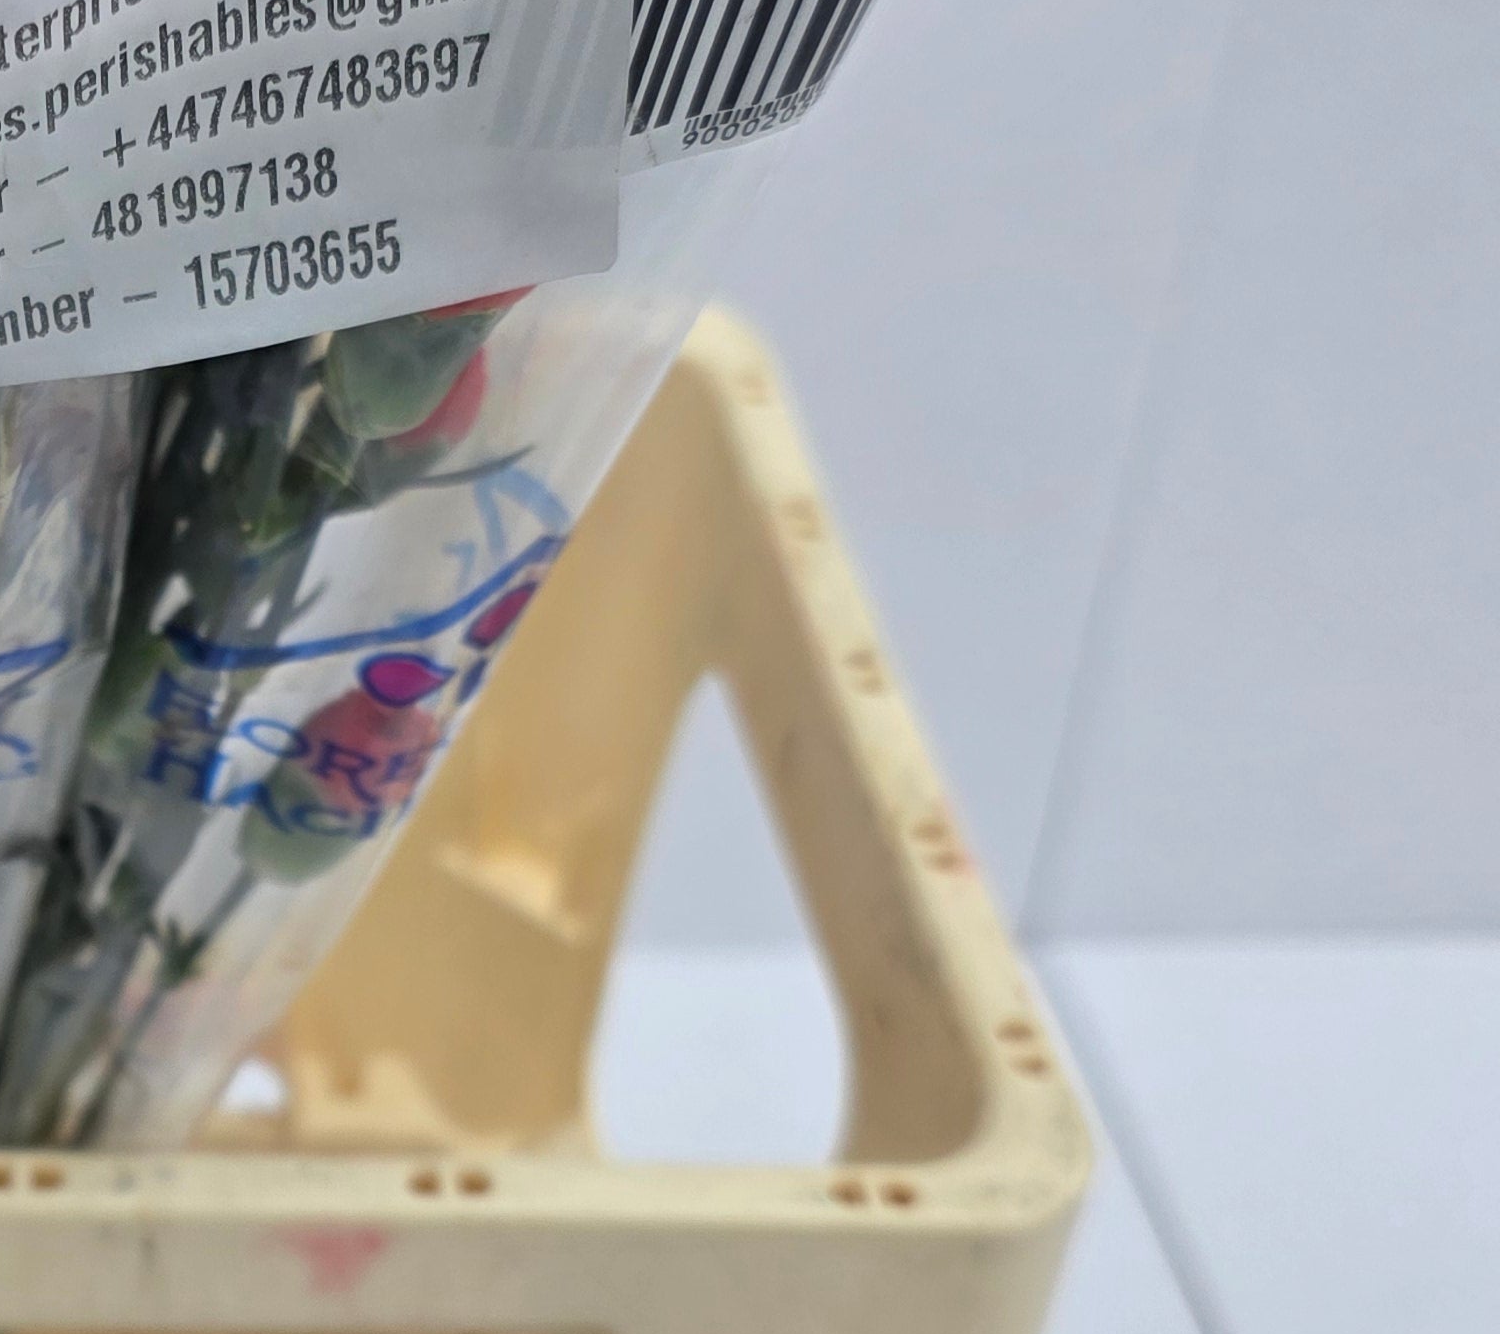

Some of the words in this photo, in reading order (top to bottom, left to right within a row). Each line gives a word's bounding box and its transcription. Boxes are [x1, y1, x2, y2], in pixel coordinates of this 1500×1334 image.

[102, 32, 492, 168] +447467483697
[91, 145, 339, 243] 481997138
[184, 217, 403, 310] 15703655
